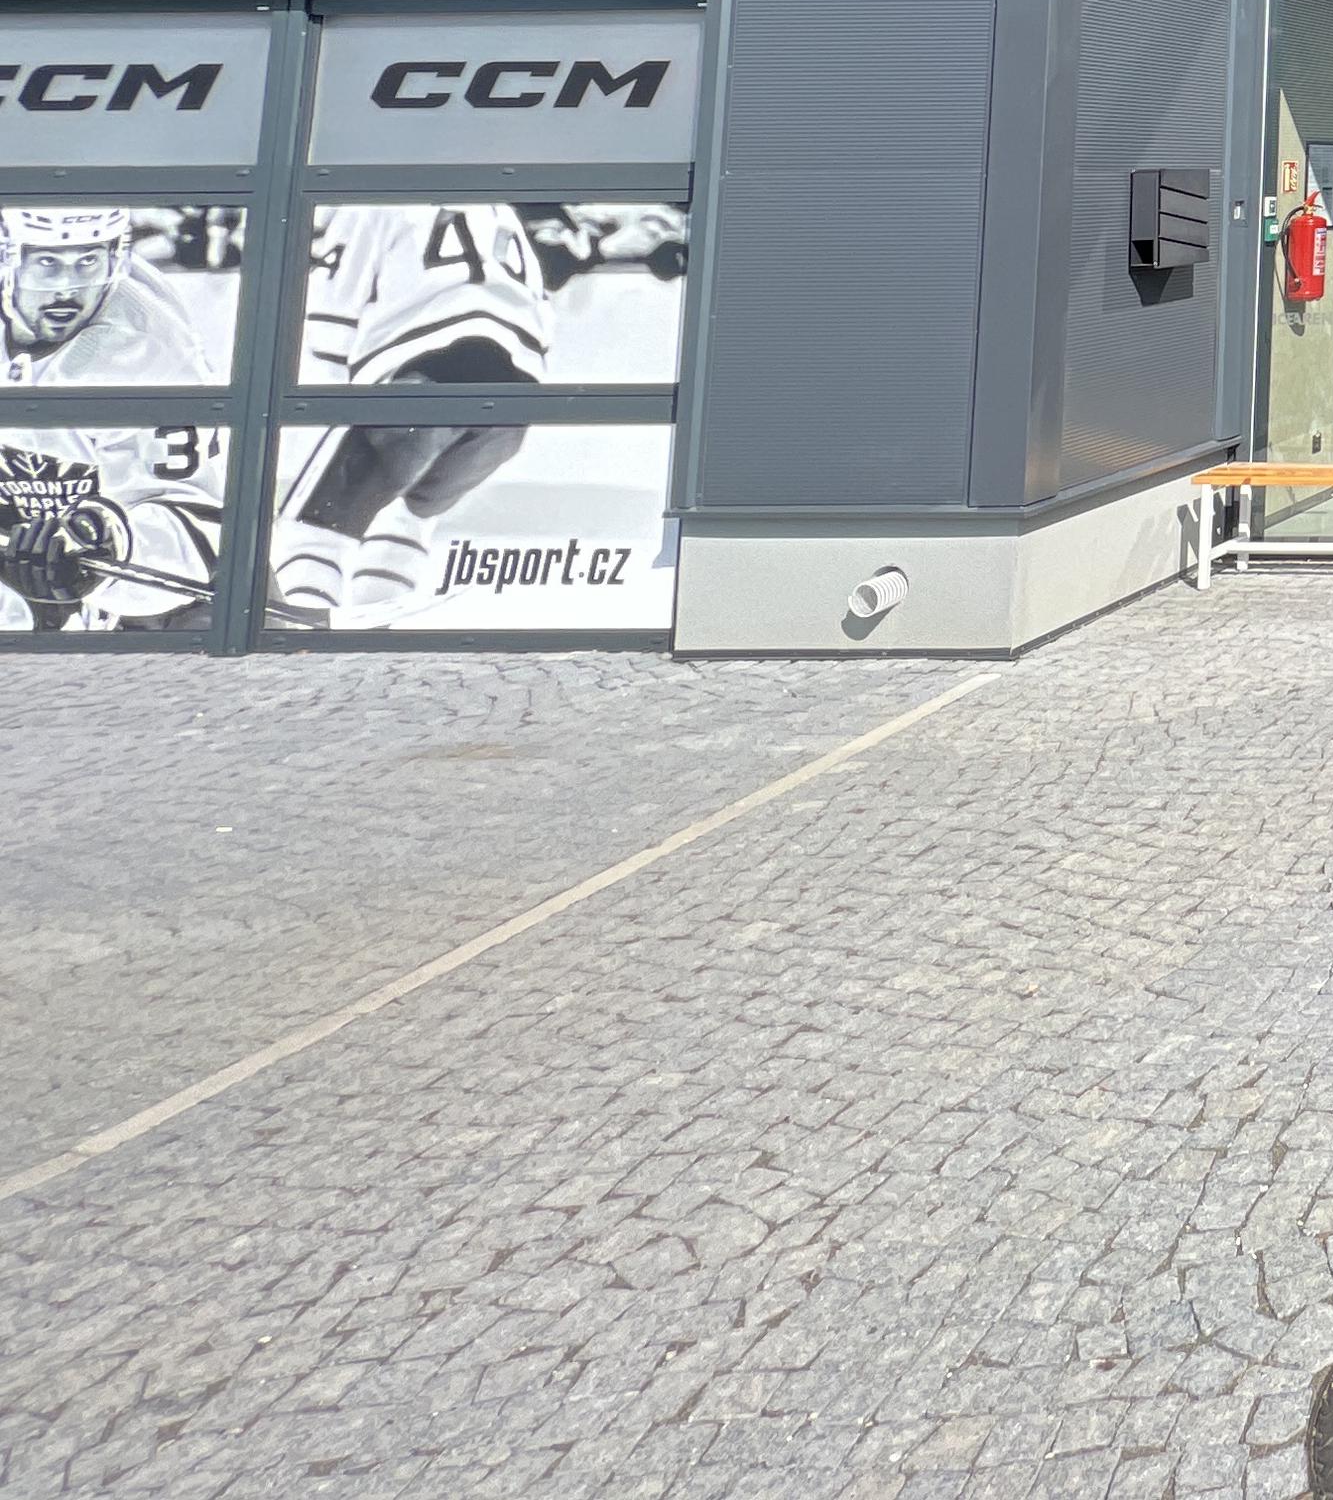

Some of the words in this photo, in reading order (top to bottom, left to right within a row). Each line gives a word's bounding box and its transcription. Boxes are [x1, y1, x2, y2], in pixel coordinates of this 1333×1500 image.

[0, 64, 224, 110] CM
[370, 60, 671, 108] CCM
[434, 538, 632, 595] jbsport.cz
